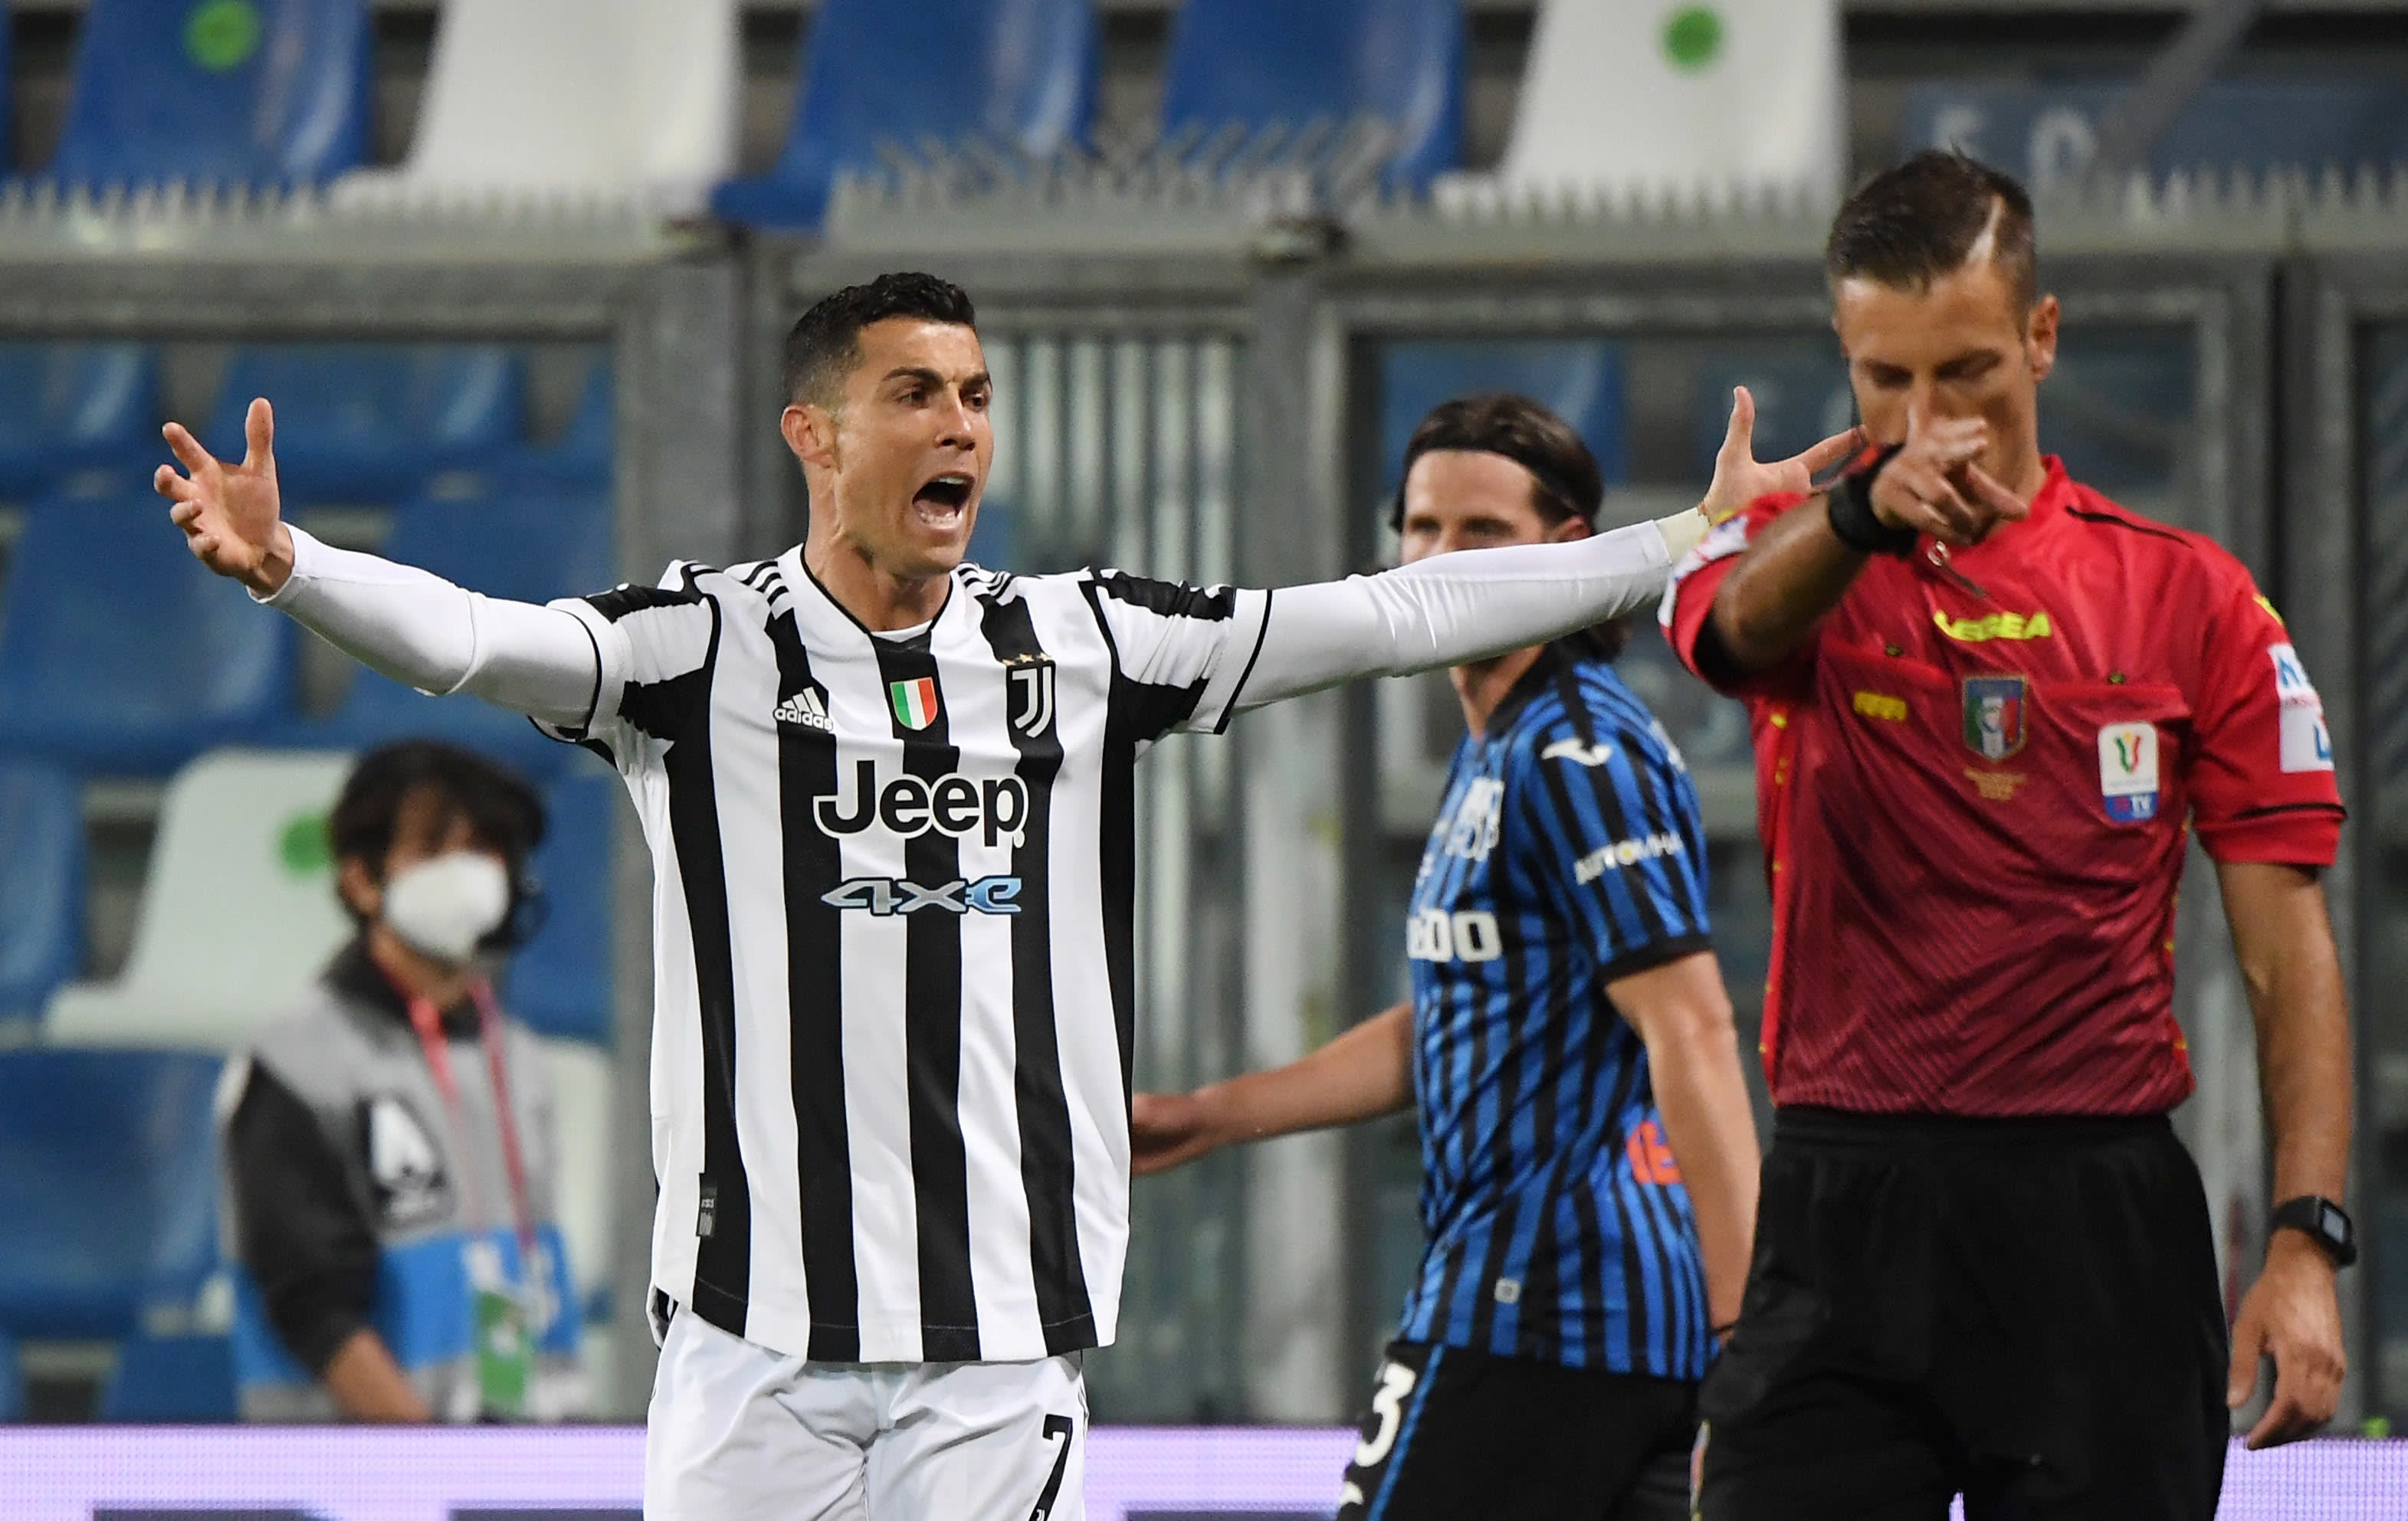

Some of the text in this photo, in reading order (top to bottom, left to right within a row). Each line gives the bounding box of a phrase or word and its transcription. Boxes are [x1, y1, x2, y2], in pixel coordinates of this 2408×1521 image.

[773, 707, 833, 732] adidas
[813, 754, 1029, 849] Jeep
[1028, 1413, 1073, 1521] 7
